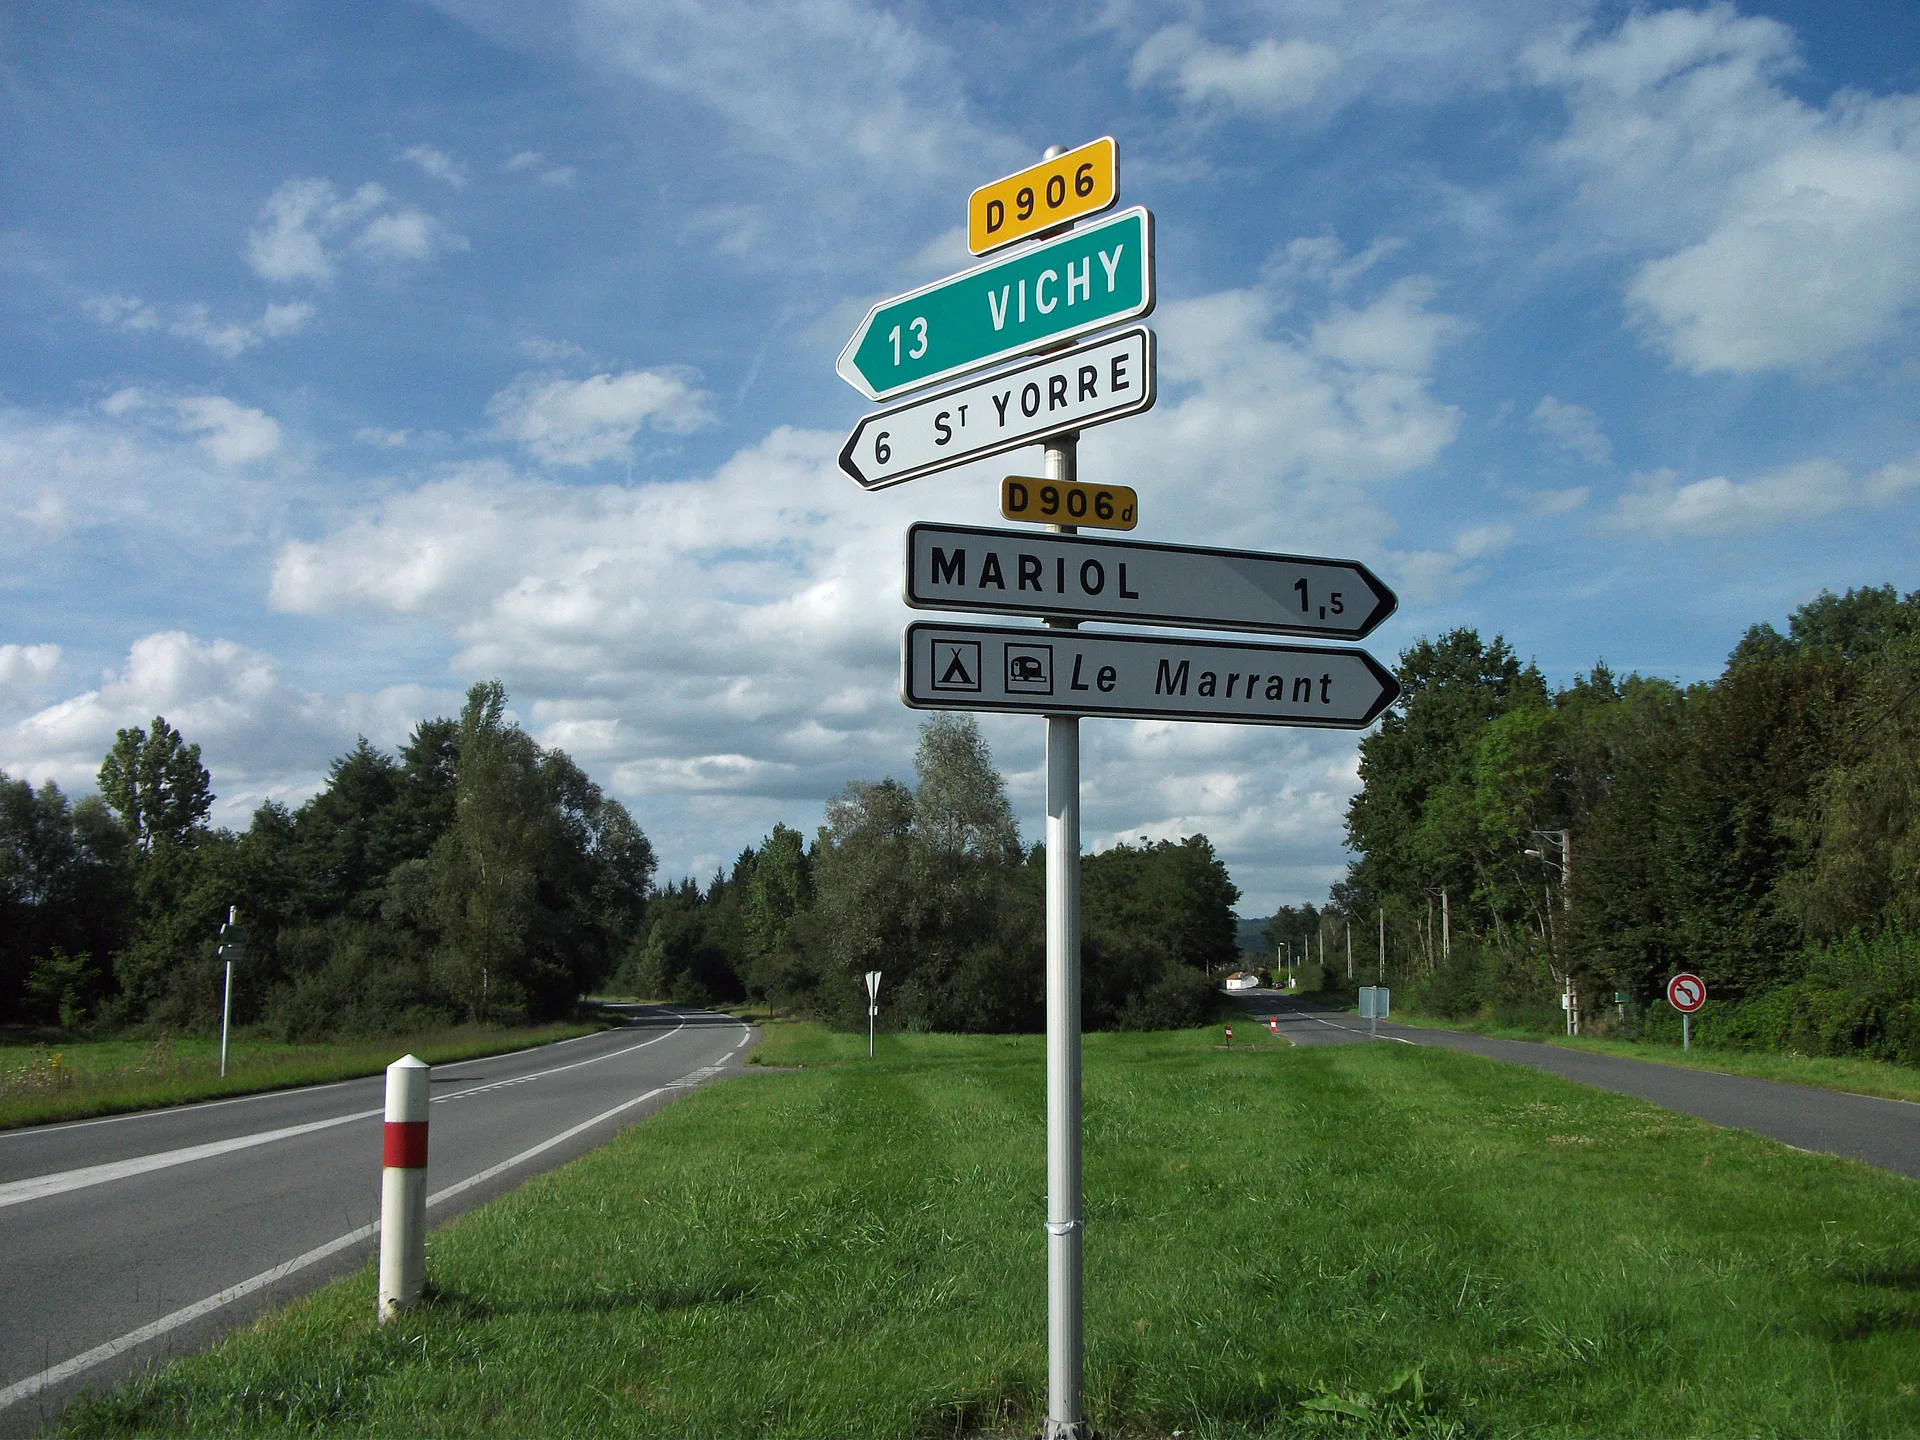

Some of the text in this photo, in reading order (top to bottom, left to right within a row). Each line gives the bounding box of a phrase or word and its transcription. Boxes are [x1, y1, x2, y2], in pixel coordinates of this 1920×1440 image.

[888, 244, 1124, 366] 13 VICHY
[875, 431, 891, 465] 6
[992, 353, 1130, 427] YORRE
[931, 546, 1344, 619] MARIOL 1,5
[1070, 653, 1332, 704] Le Marrant
